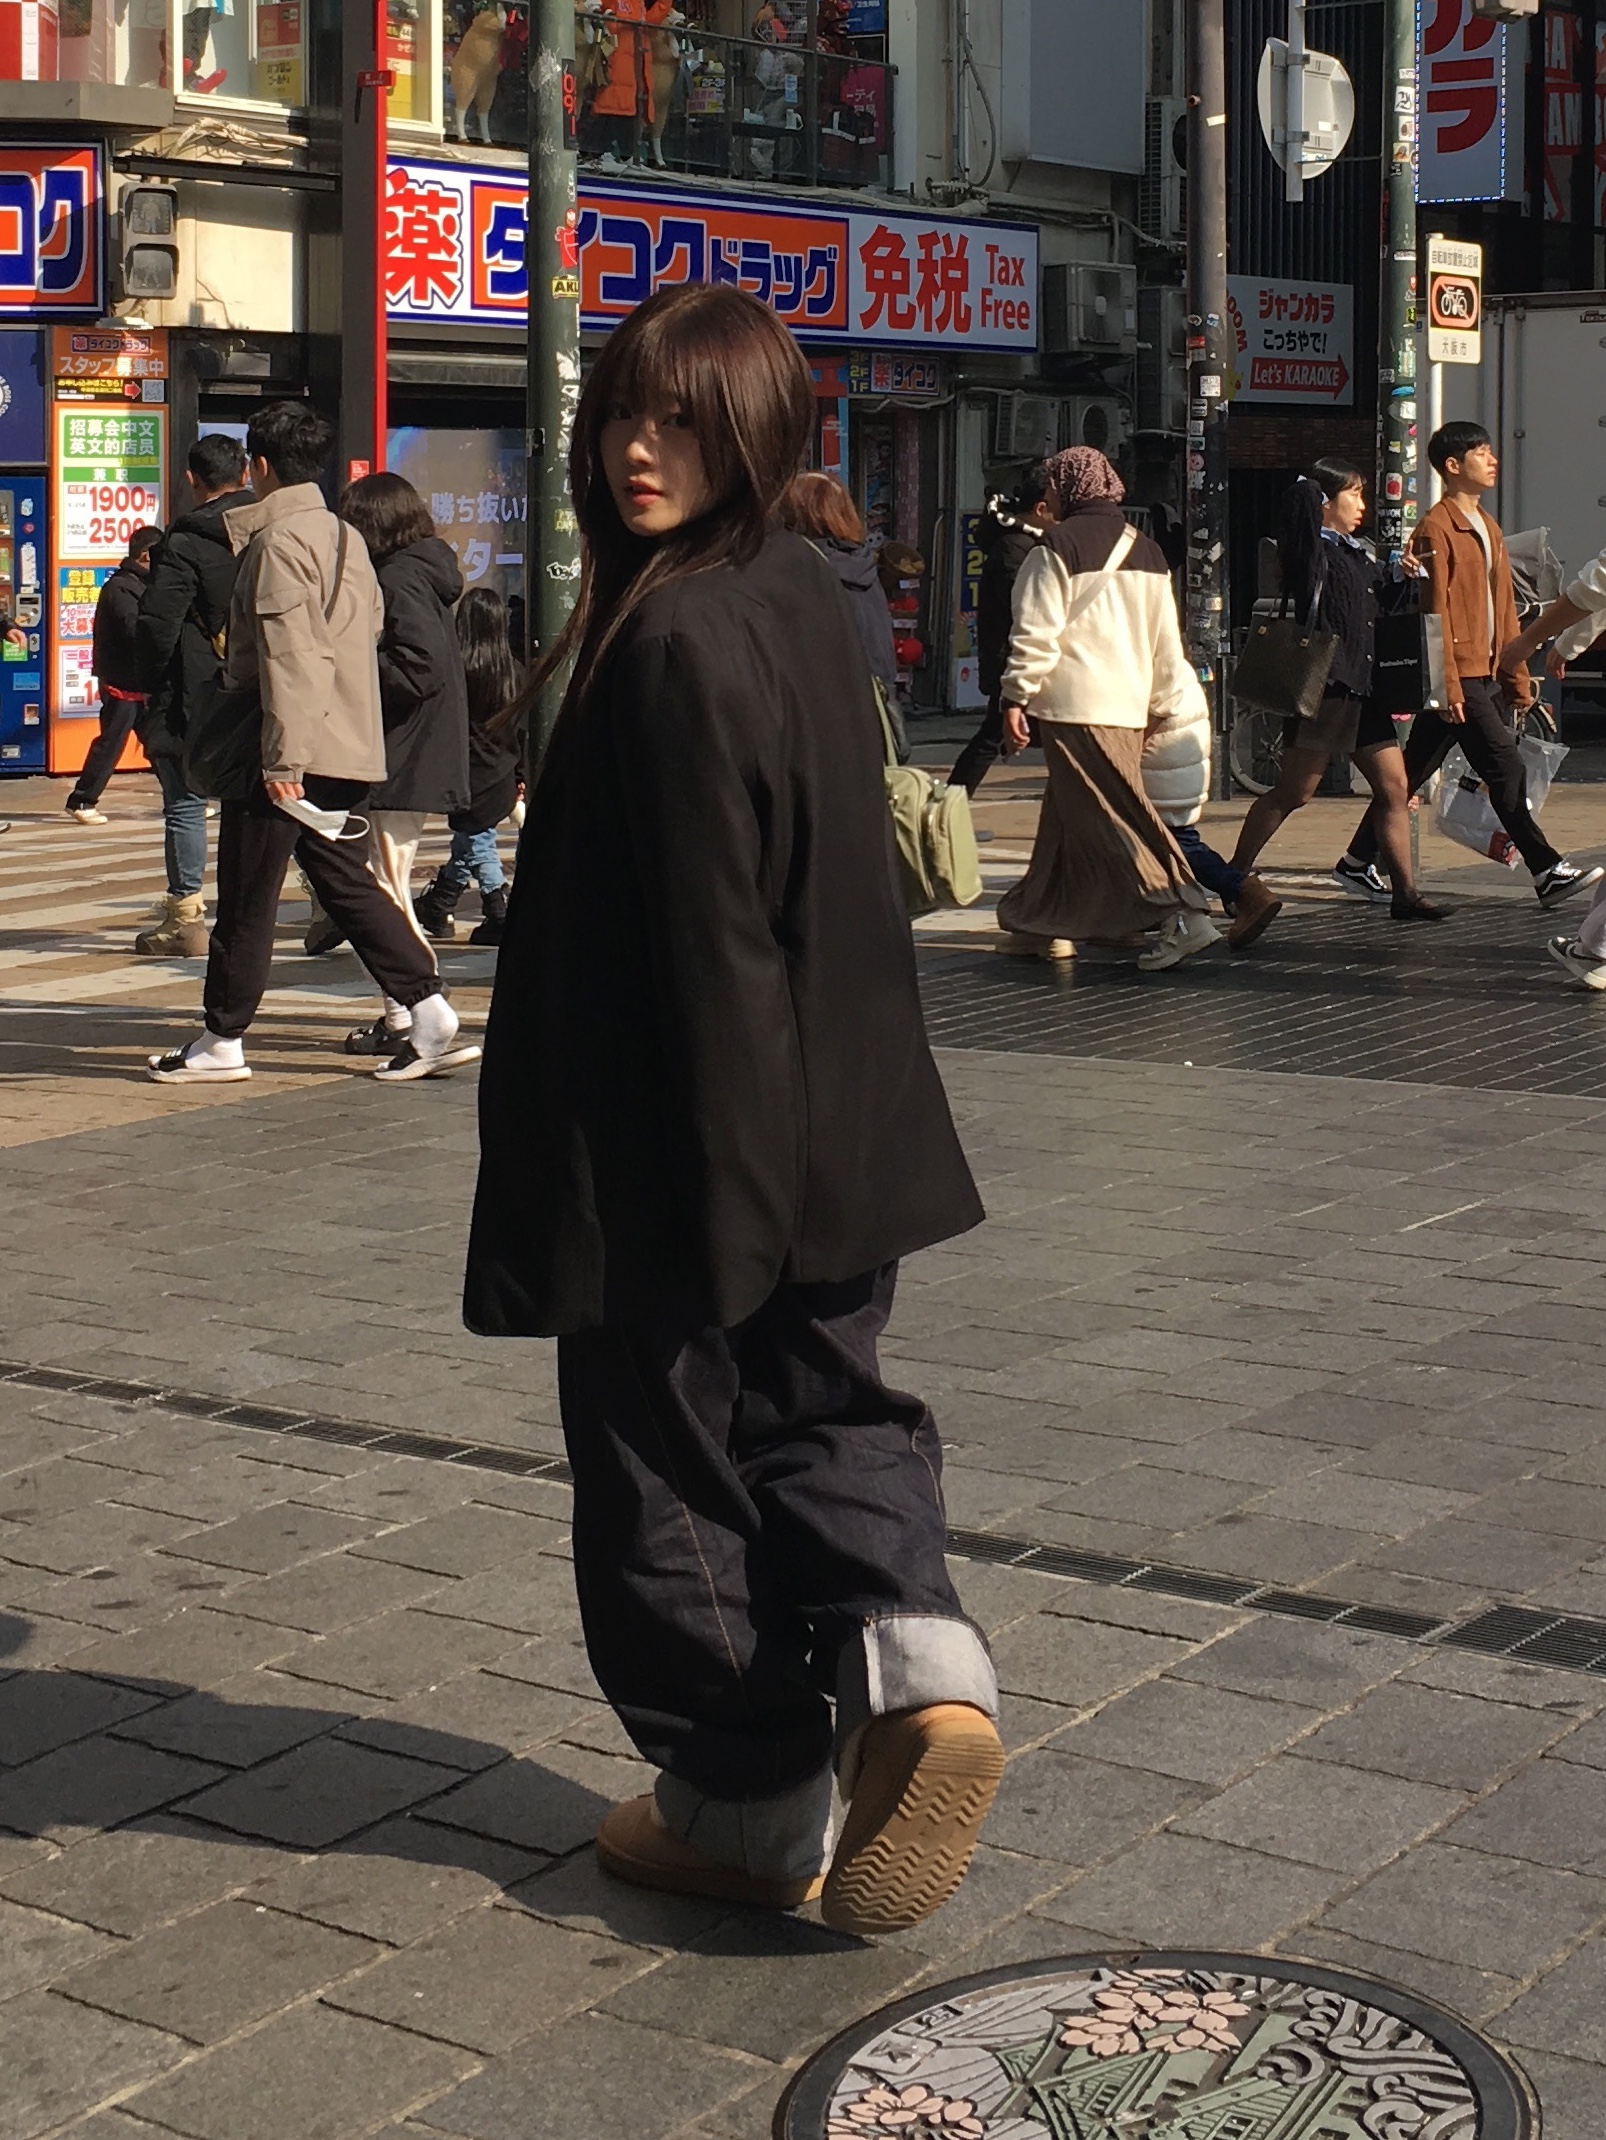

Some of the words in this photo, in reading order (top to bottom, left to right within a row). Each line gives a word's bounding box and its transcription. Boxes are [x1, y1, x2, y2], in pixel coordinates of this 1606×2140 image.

[386, 182, 460, 302] 薬
[859, 224, 972, 334] 免税
[985, 244, 1026, 287] Tax
[980, 287, 1031, 331] Free
[1258, 288, 1335, 324] ジャンカラ
[1263, 328, 1328, 354] こっちやで!
[60, 356, 164, 377] スタッフ募集中
[849, 364, 869, 377] 2F
[892, 360, 937, 391] ダイコク
[1254, 362, 1282, 384] Let's
[1284, 364, 1340, 387] KARAOKE
[851, 380, 869, 392] 1F
[69, 419, 155, 437] 招募会中文
[69, 437, 155, 455] 英文的店员
[450, 538, 524, 582] ター
